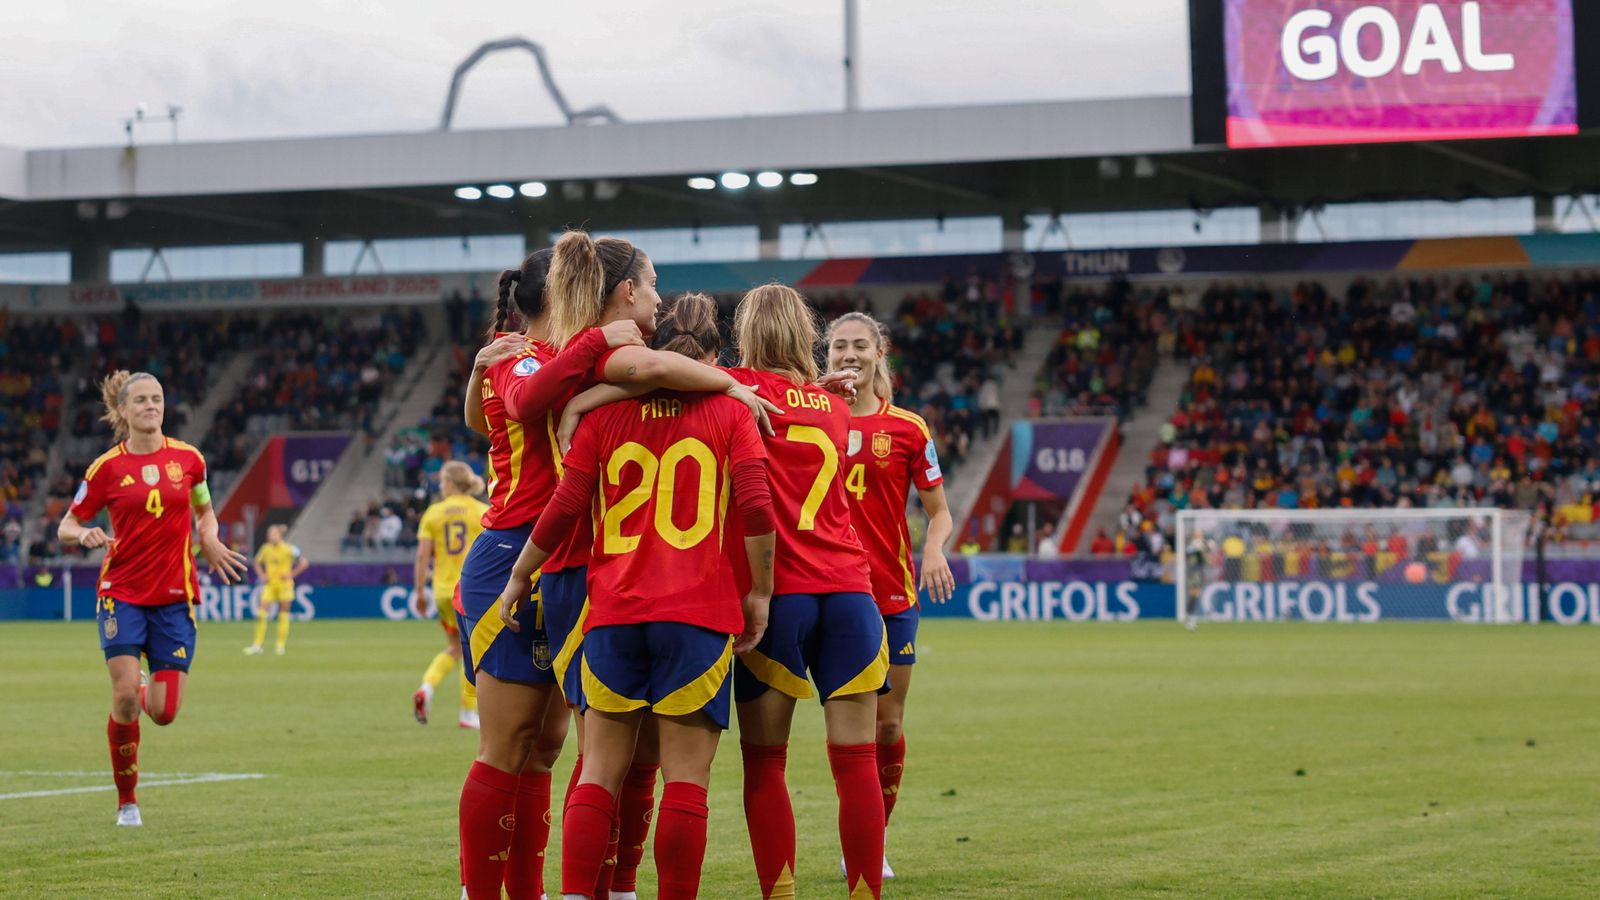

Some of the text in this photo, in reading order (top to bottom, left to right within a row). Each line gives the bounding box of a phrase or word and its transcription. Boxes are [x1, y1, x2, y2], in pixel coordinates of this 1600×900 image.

[1281, 1, 1515, 80] GOAL
[1064, 251, 1129, 274] THUN
[786, 388, 832, 413] OLGA
[603, 436, 717, 554] 20
[786, 424, 838, 530] 7
[145, 489, 165, 519] 4
[443, 519, 468, 555] 13
[967, 580, 1141, 622] GRIFOLS
[1201, 581, 1382, 622] GRIFOLS
